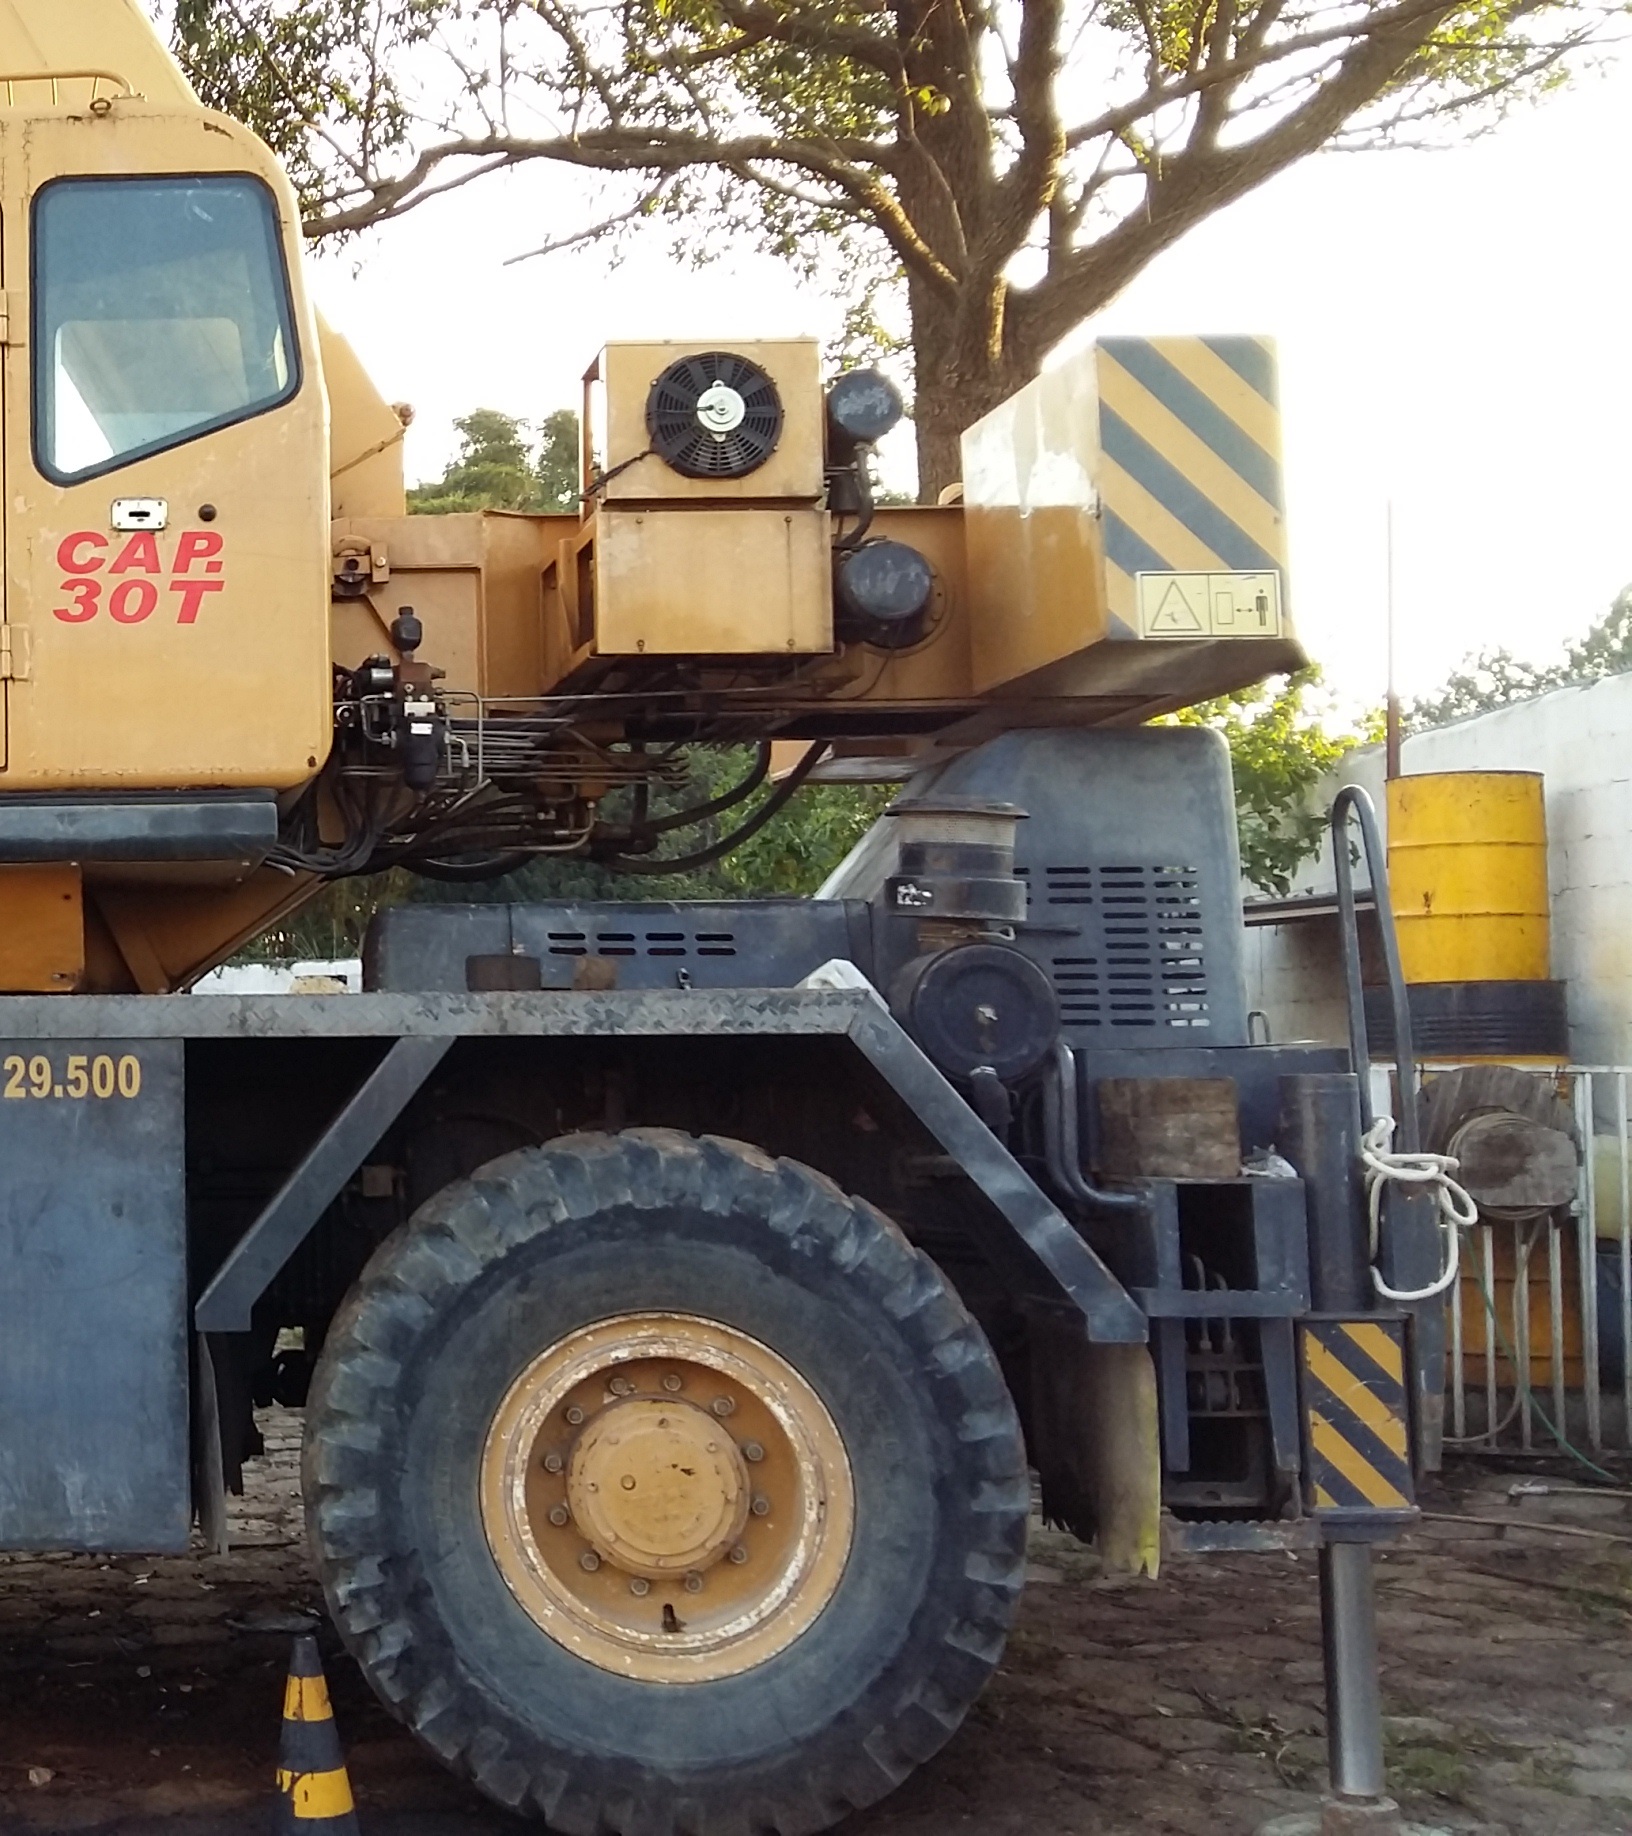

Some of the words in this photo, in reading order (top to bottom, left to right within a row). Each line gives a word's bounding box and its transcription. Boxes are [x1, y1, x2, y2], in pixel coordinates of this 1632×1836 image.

[57, 531, 223, 575] CAP.
[53, 577, 224, 624] 30T
[3, 1054, 142, 1098] 29.500
